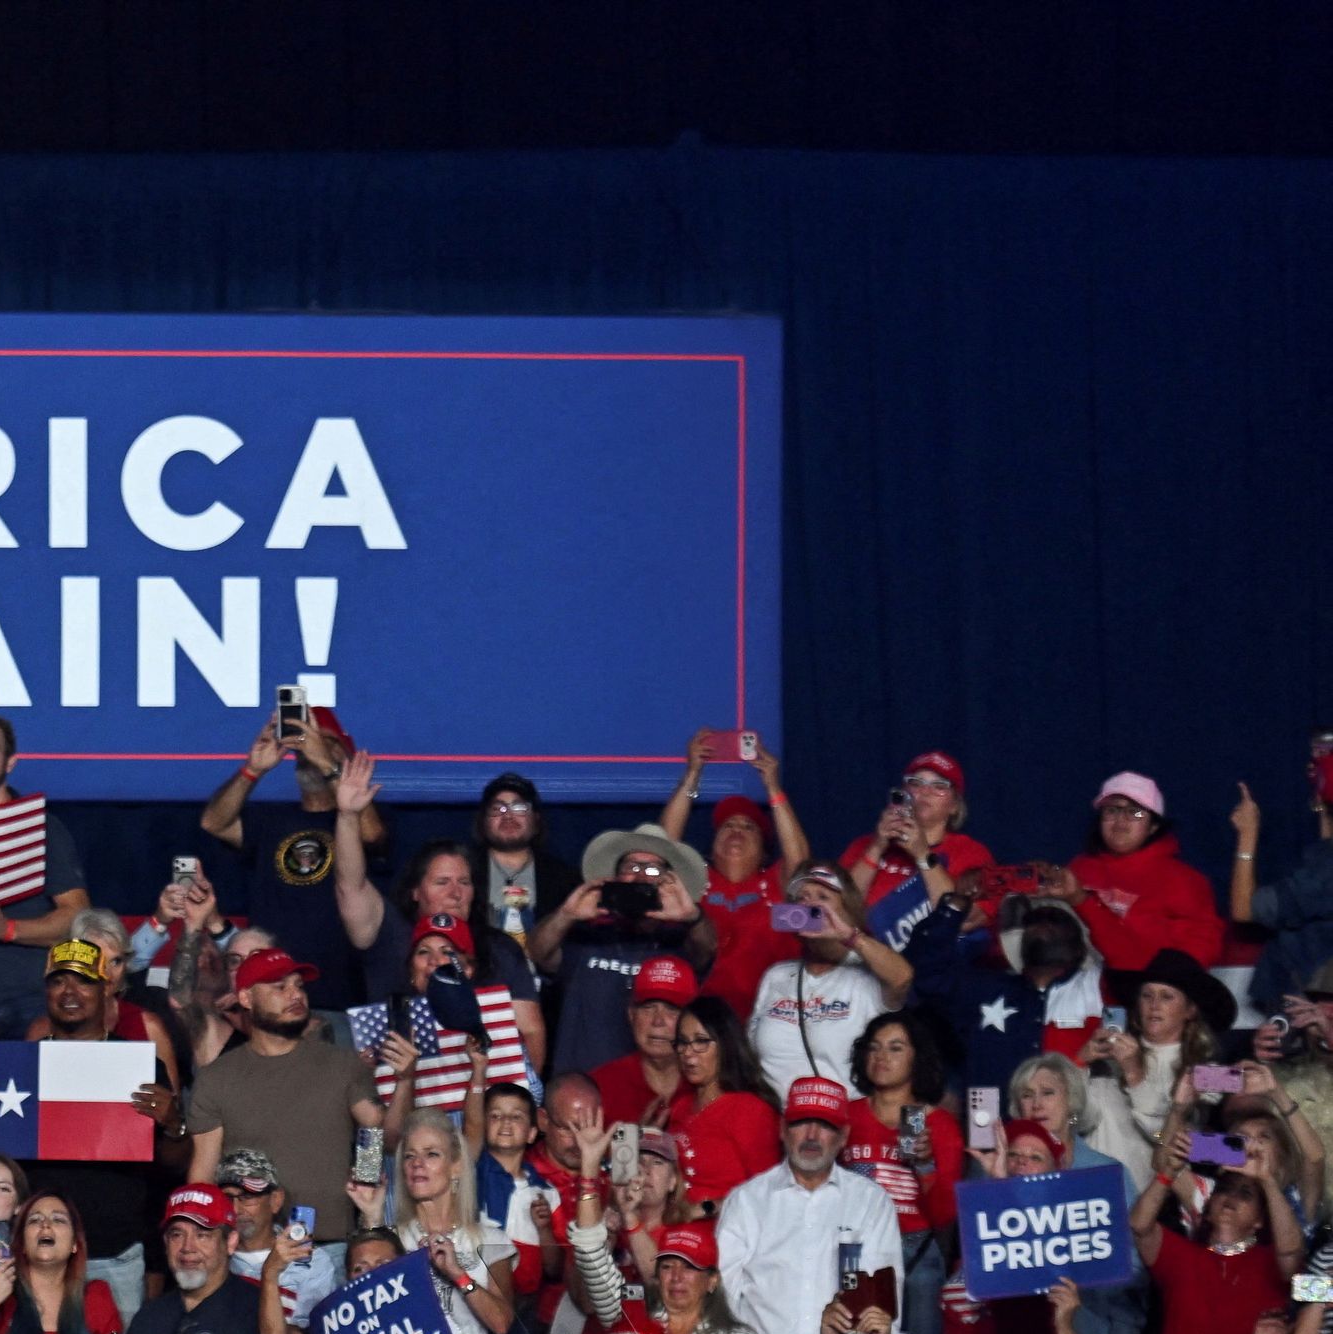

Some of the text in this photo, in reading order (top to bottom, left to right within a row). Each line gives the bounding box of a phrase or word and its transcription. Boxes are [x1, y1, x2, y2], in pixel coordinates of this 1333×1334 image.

[793, 1084, 845, 1097] MAKE AMERICA
[794, 1096, 818, 1107] GREAT
[170, 1190, 214, 1206] TRUMP
[976, 1198, 1111, 1241] LOWER
[982, 1230, 1113, 1272] PRICES
[358, 1273, 410, 1315] TAX
